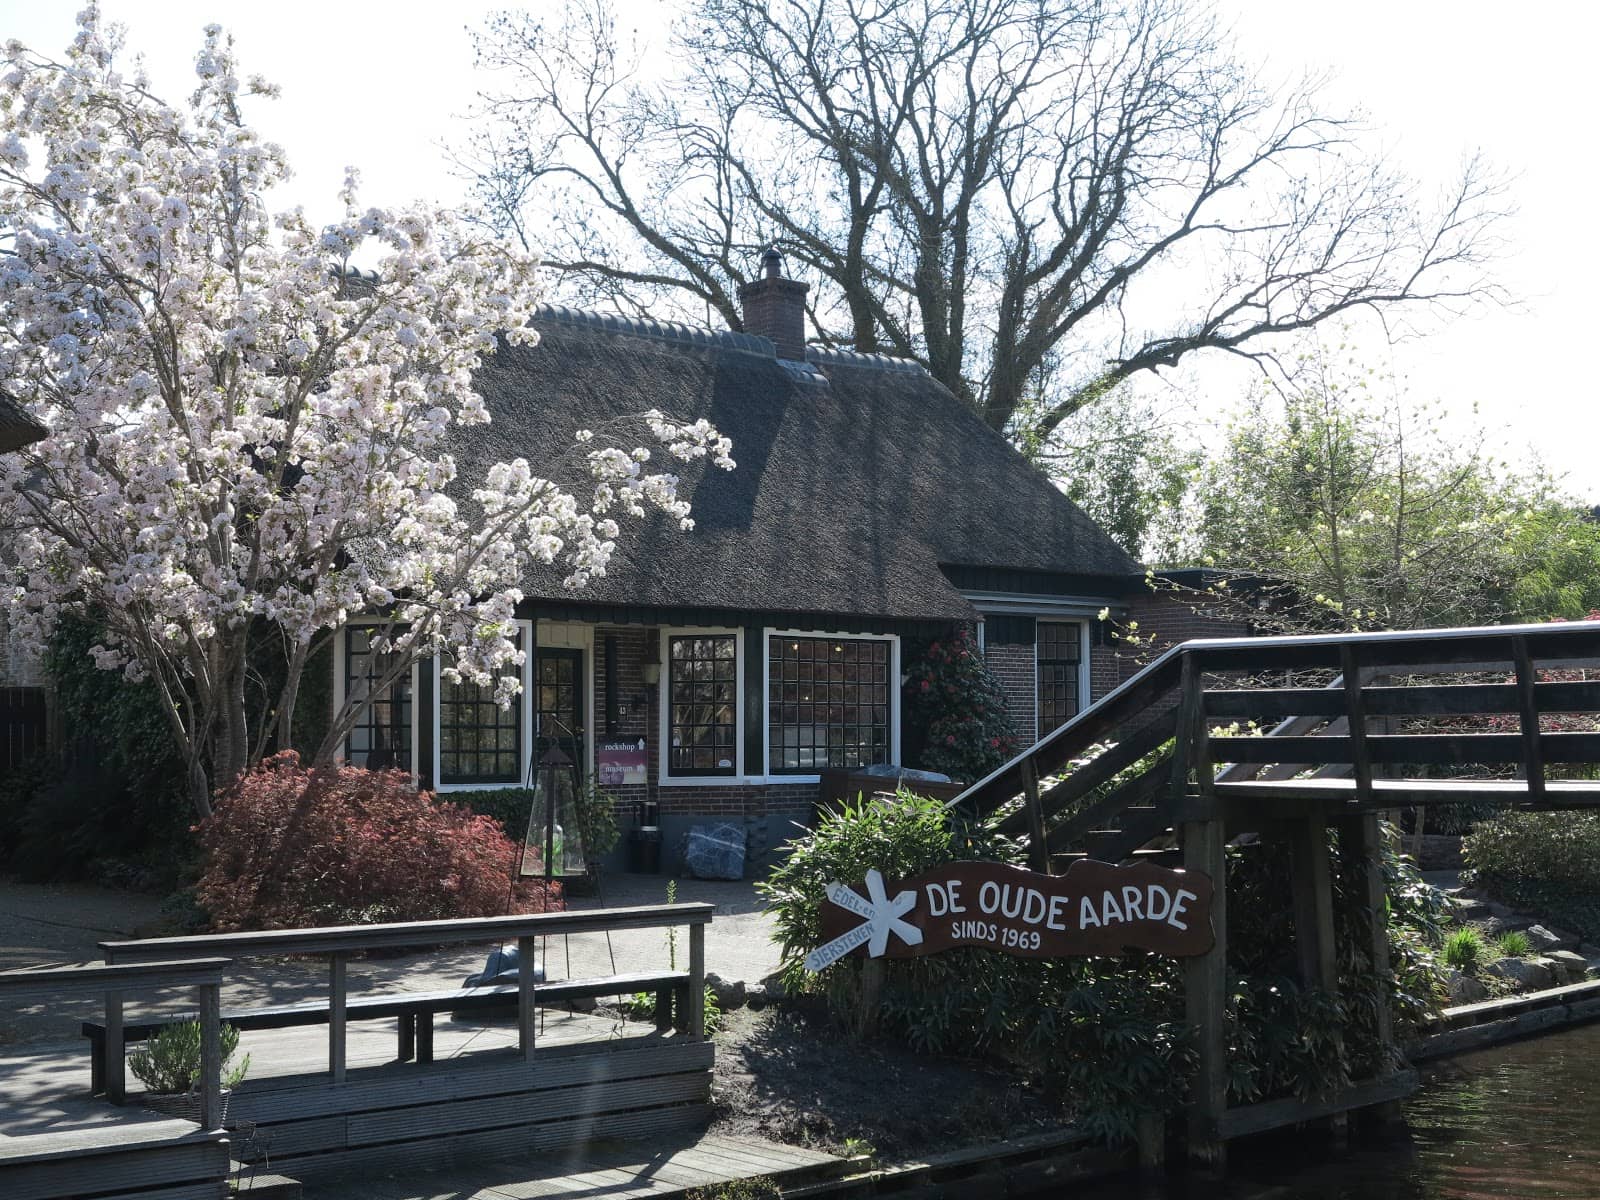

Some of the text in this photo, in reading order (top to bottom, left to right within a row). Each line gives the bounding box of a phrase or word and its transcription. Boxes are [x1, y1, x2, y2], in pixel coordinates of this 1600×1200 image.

[605, 743, 635, 752] rockshop
[605, 765, 633, 773] museum
[926, 880, 1198, 930] DE OUDE AARDE
[811, 922, 876, 968] SIERSTENEN
[951, 921, 1042, 950] SINDS 1969
